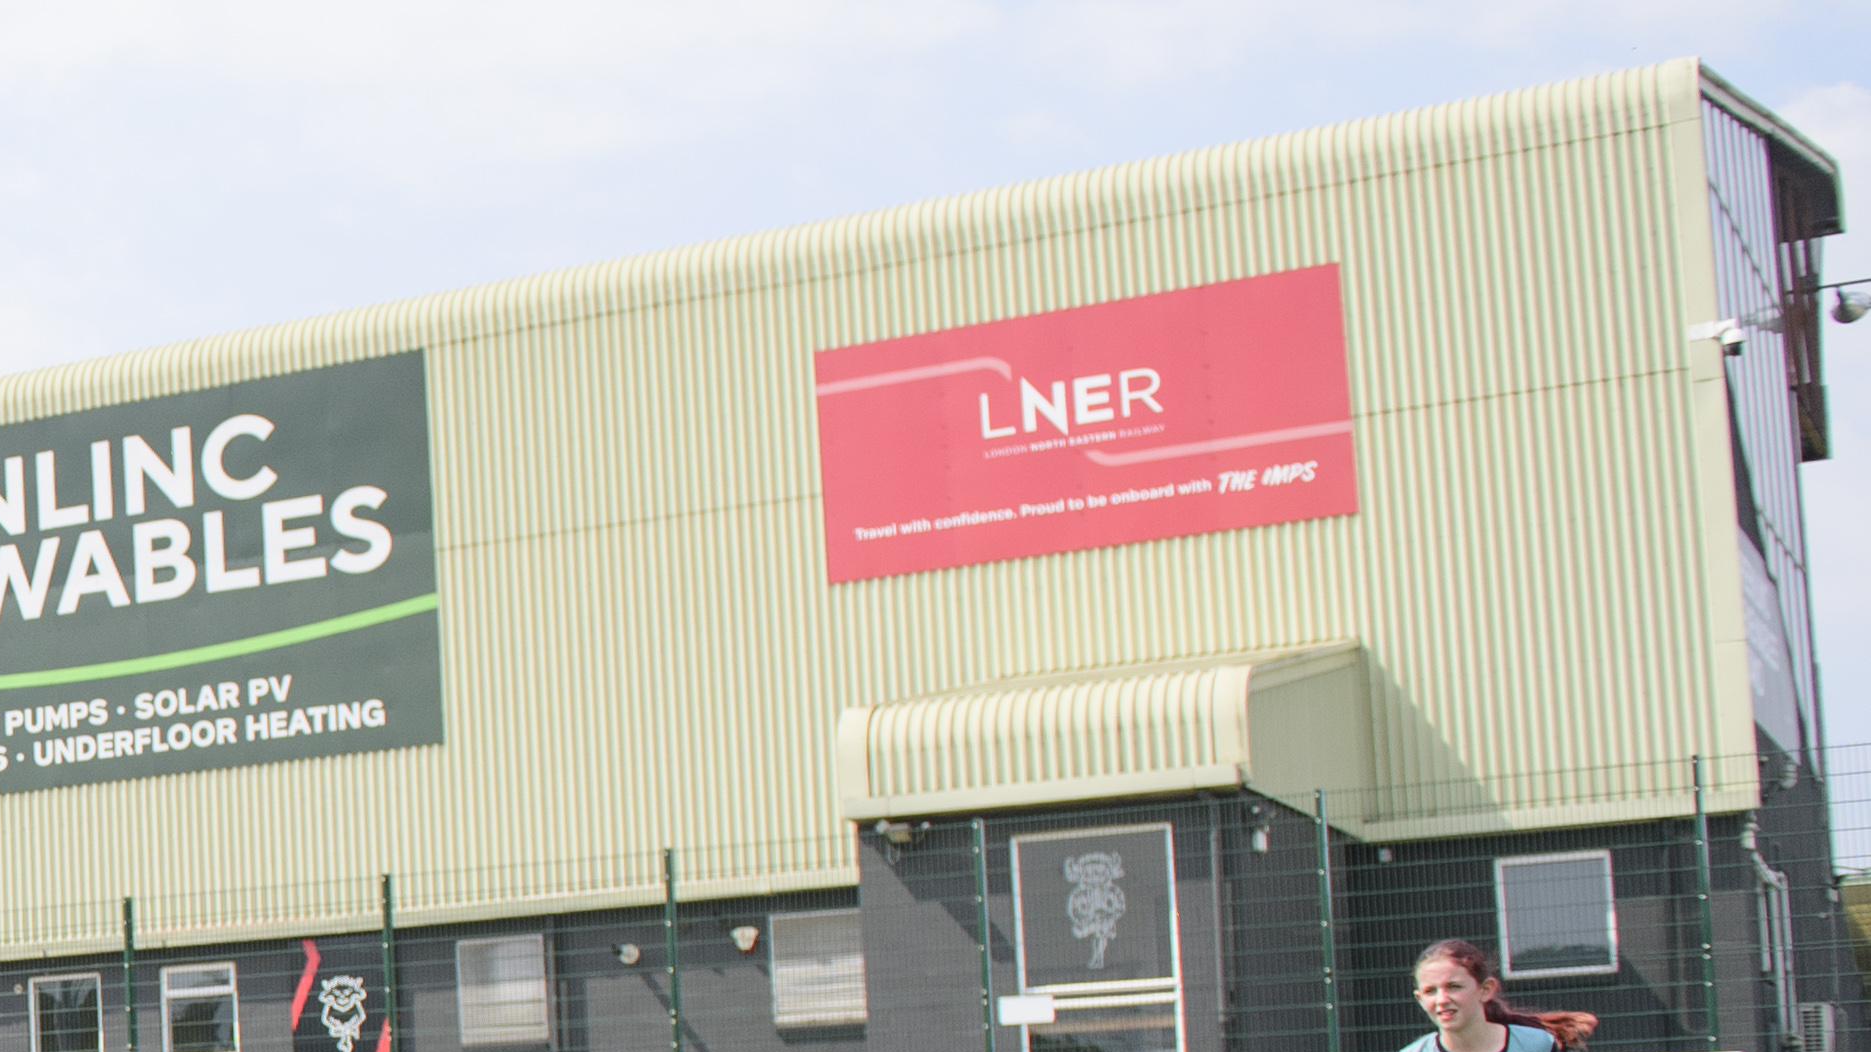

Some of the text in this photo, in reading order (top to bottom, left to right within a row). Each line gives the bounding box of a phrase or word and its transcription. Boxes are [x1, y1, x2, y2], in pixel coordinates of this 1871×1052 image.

[980, 368, 1163, 438] LNER
[1030, 438, 1066, 452] NORTH
[1069, 431, 1116, 447] EASTERN
[1119, 424, 1165, 438] RAILWAY
[855, 461, 1318, 541] Travel with confidence. Proud to be onboard with THE IMPS
[5, 699, 108, 736] PUMPS
[135, 682, 240, 719] SOLAR
[248, 674, 291, 706] PV
[33, 718, 237, 767] UNDERFLOOR
[246, 699, 386, 741] HEATING
